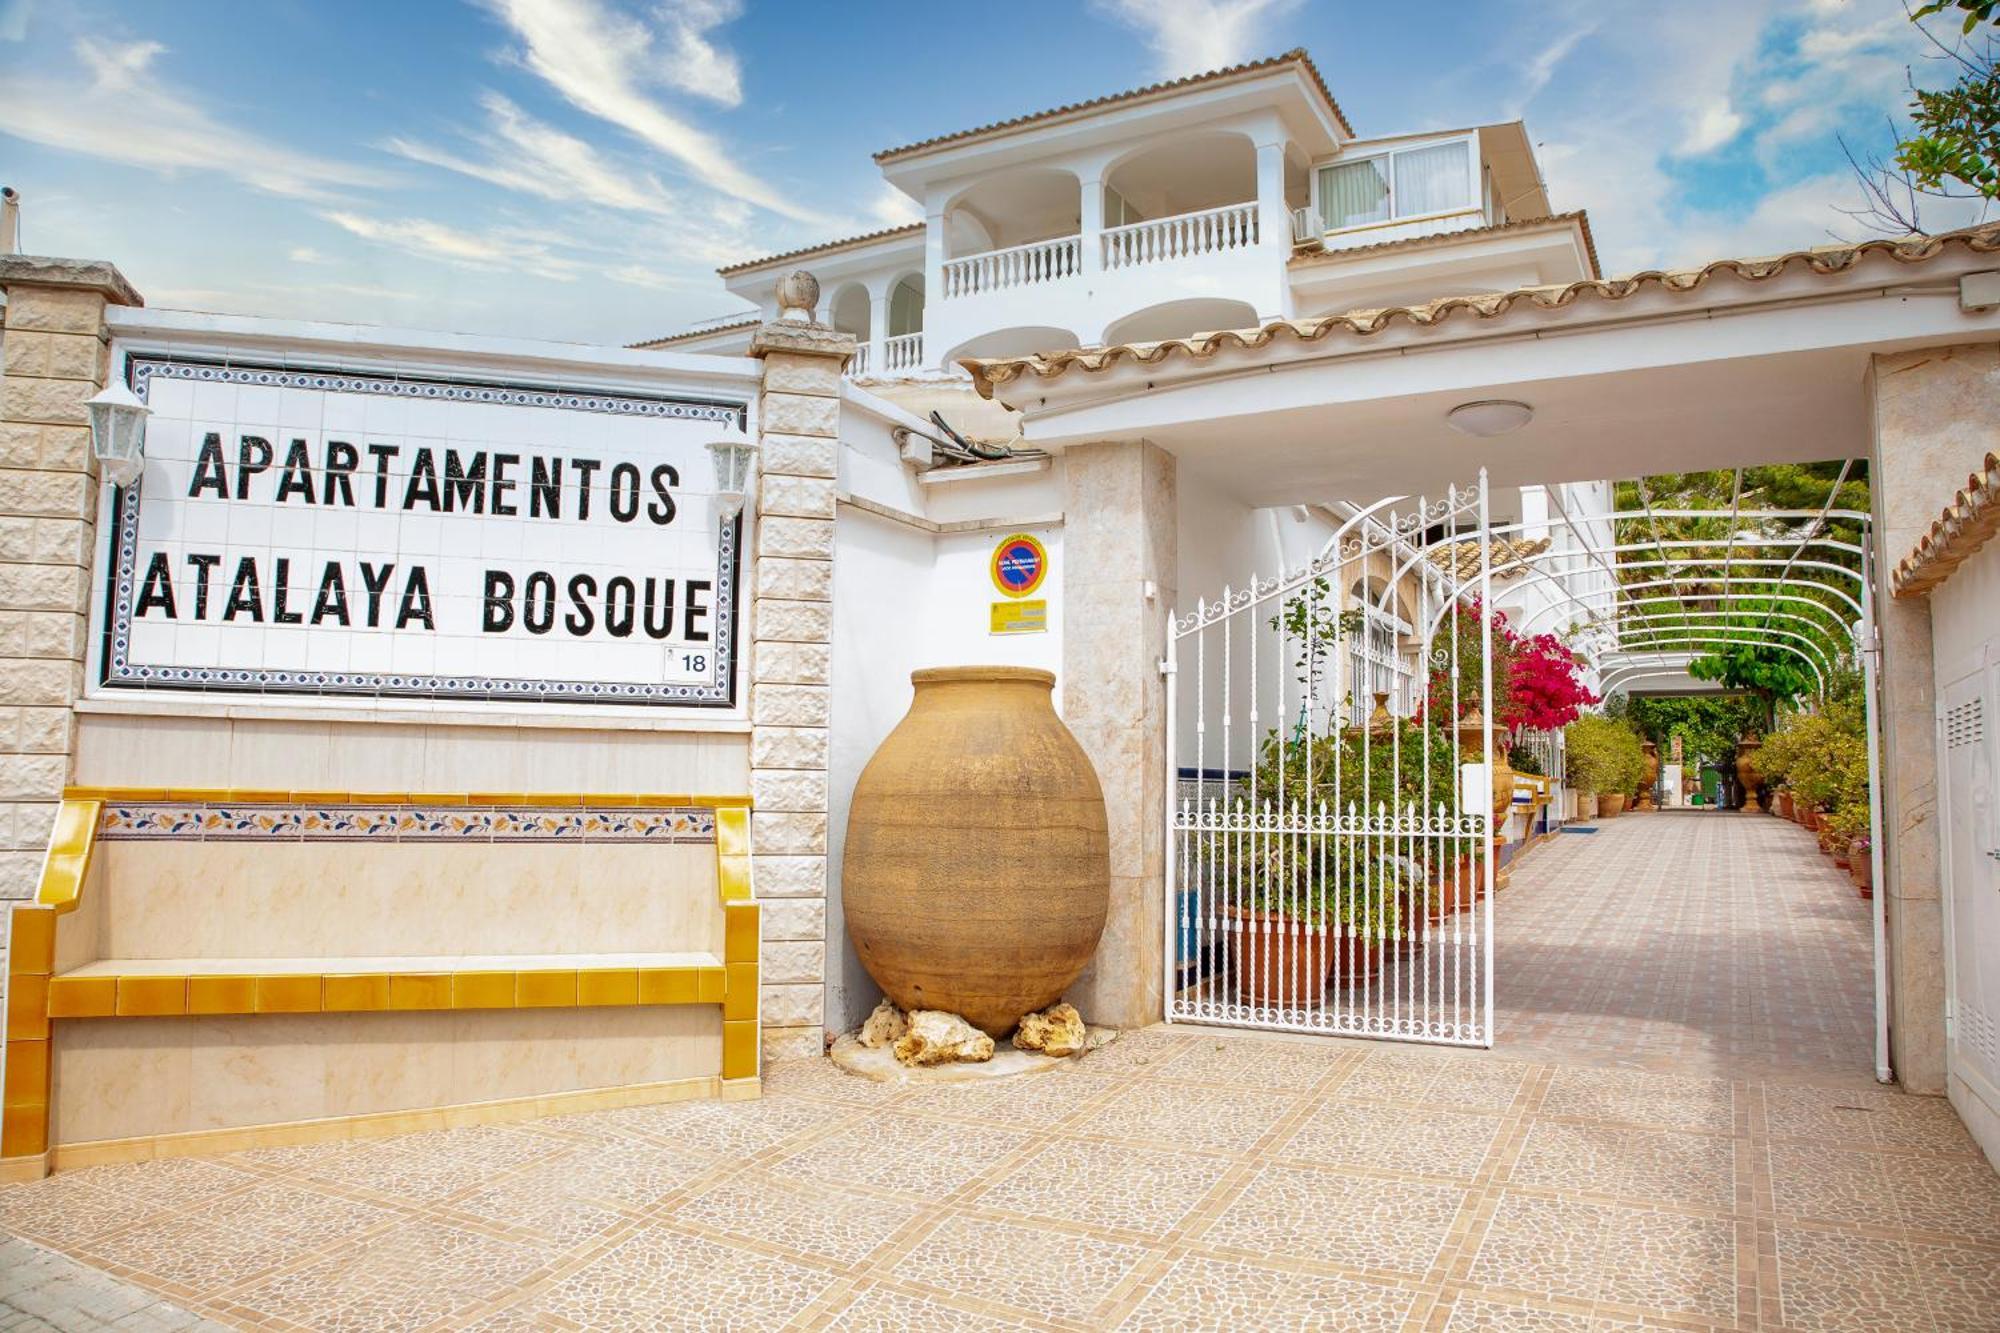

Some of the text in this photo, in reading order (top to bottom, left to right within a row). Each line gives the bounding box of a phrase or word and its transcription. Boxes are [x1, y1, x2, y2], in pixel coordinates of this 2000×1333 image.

[188, 431, 681, 525] APARTAMENTOS
[134, 551, 710, 642] ATALAYA BOSQUE
[682, 654, 706, 672] 18
